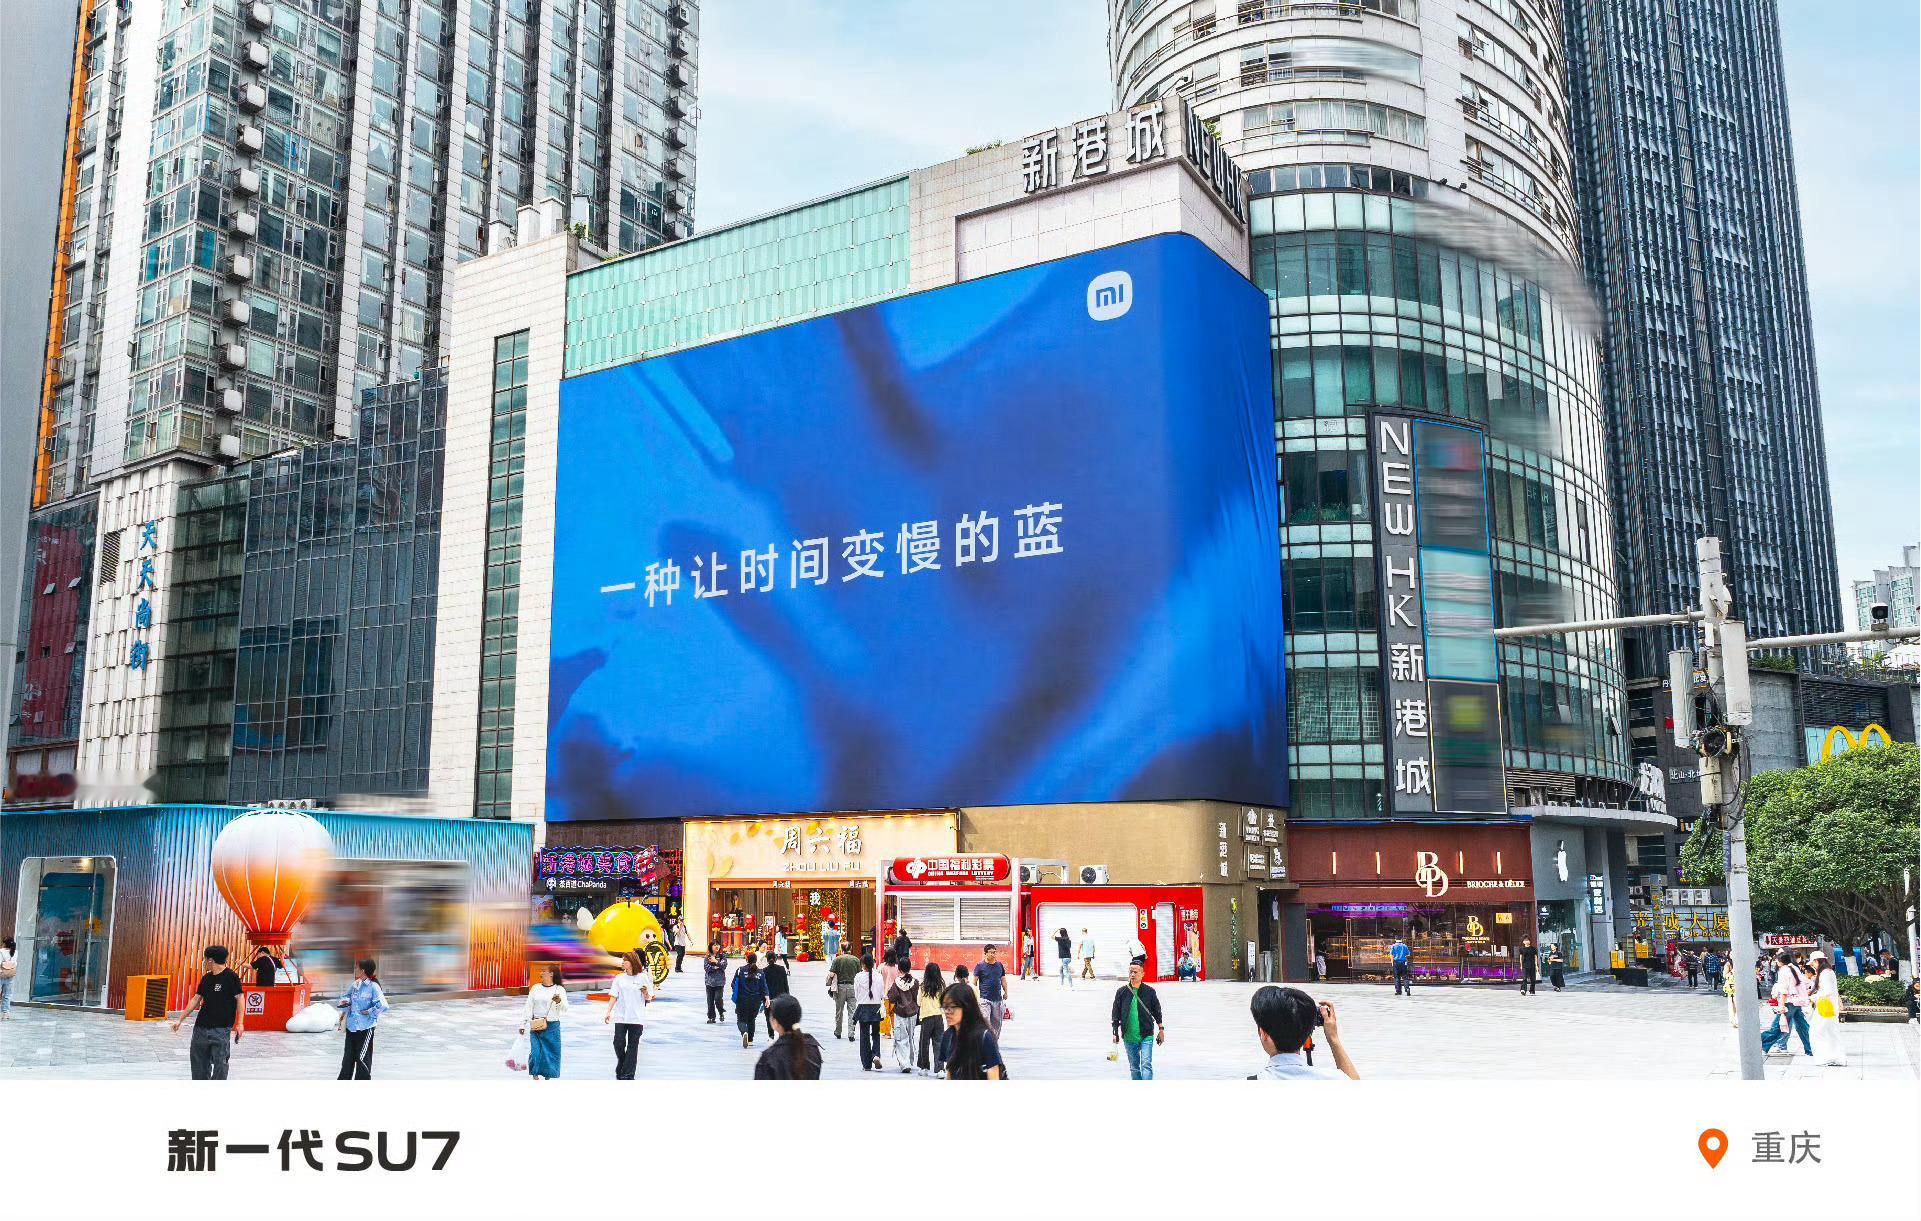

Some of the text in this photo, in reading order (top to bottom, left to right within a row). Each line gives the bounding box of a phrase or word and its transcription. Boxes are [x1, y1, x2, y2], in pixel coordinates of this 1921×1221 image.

[1022, 102, 1166, 192] 新港城
[130, 519, 158, 671] 天天尚街
[600, 501, 1064, 607] 一种让时间变慢的蓝
[1391, 642, 1432, 795] 新港城
[781, 825, 863, 855] 周六福
[927, 858, 995, 871] 中国福利彩票
